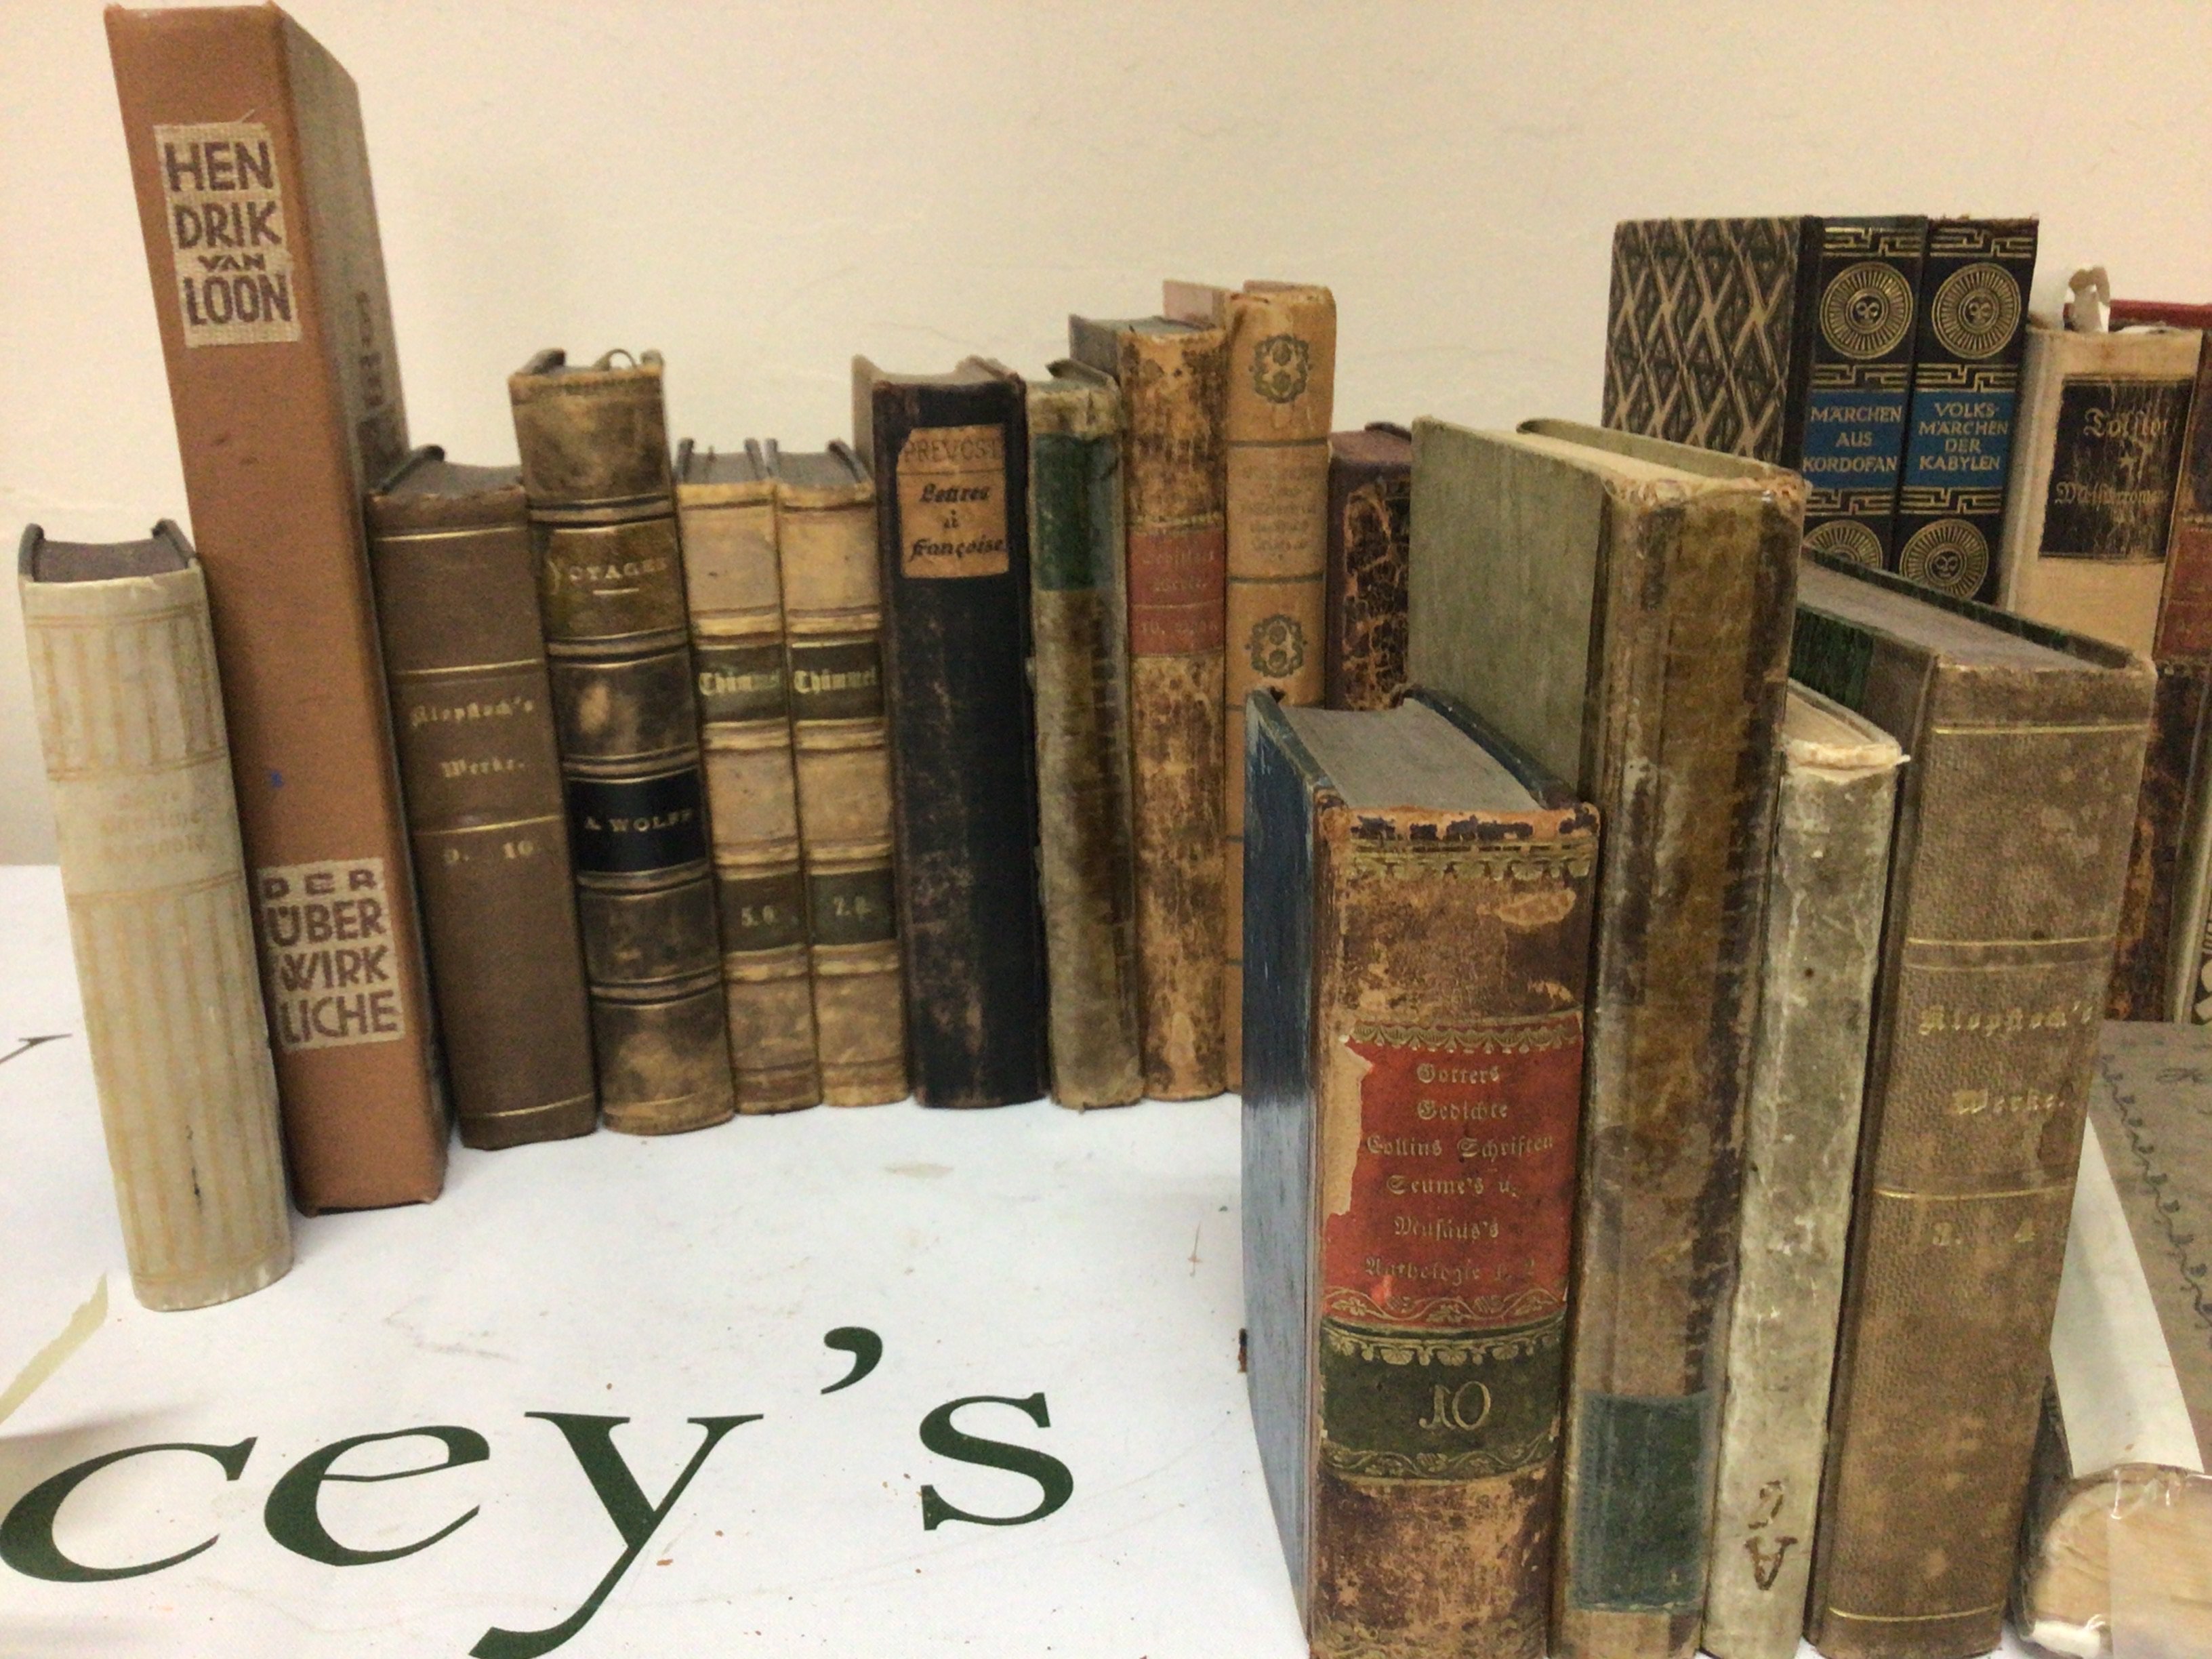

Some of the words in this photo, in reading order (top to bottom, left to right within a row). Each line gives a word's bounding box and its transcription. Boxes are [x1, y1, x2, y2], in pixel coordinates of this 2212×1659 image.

[164, 140, 274, 191] HEN
[173, 201, 282, 249] DRIK
[198, 253, 266, 272] VAN
[183, 274, 292, 326] LOON
[1835, 430, 1873, 447] AUS
[1945, 437, 1982, 454] DER
[1801, 455, 1898, 472] KORDOFAN
[1919, 455, 2001, 472] KABYLEN
[263, 868, 377, 900] DER
[267, 898, 386, 947] ÜBER
[280, 945, 390, 992] WIRK
[279, 989, 398, 1044] LICHE
[1418, 1380, 1491, 1431] 10
